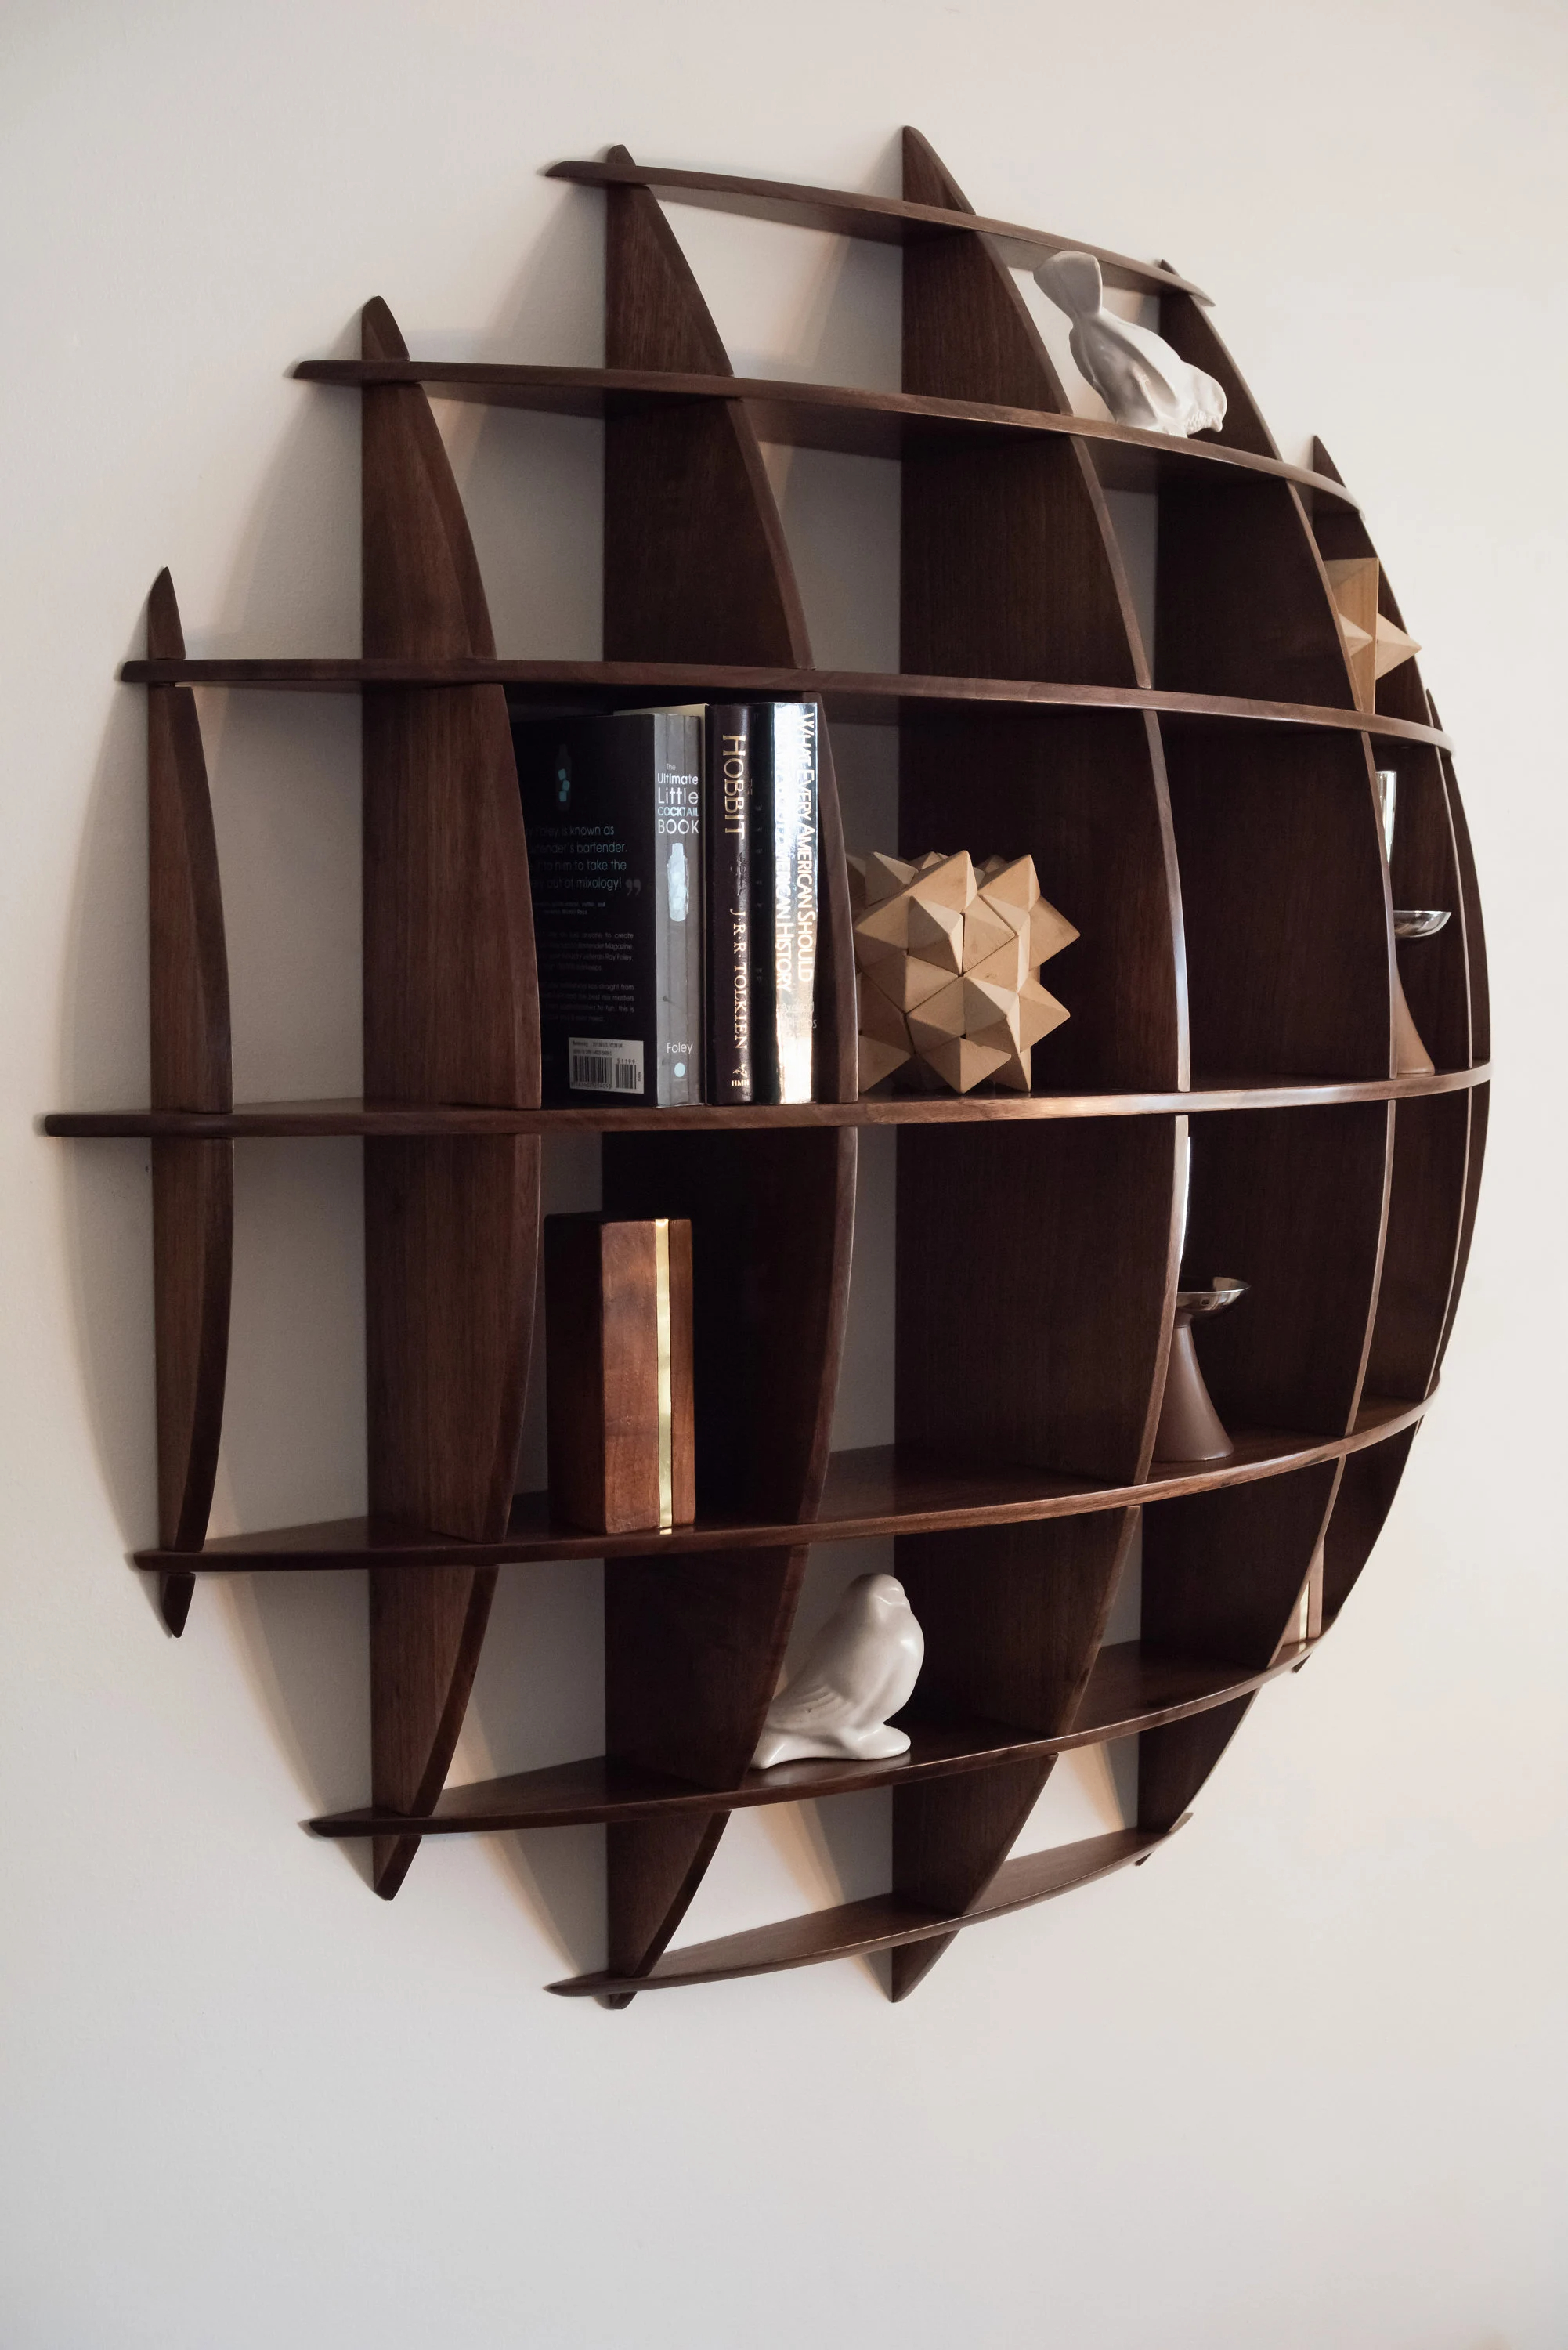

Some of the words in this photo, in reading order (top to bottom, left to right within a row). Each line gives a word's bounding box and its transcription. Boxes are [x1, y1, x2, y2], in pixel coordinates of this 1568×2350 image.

[657, 772, 699, 785] Ultimate
[722, 734, 746, 840] HOBBIT
[796, 768, 815, 821] EVERY
[658, 786, 699, 805] Little
[657, 806, 699, 817] COCKTAIL
[569, 825, 602, 836] known
[603, 826, 615, 836] as
[658, 819, 699, 835] BOOK
[576, 840, 627, 853] bartender.
[574, 861, 584, 871] to
[587, 860, 609, 871] take
[610, 859, 627, 870] the
[797, 822, 815, 908] AMERICAN
[614, 931, 634, 940] create
[797, 910, 816, 982] SHOULD
[775, 922, 795, 992] HISTORY
[733, 962, 748, 1050] TOLKIEN
[667, 1042, 693, 1055] Foley
